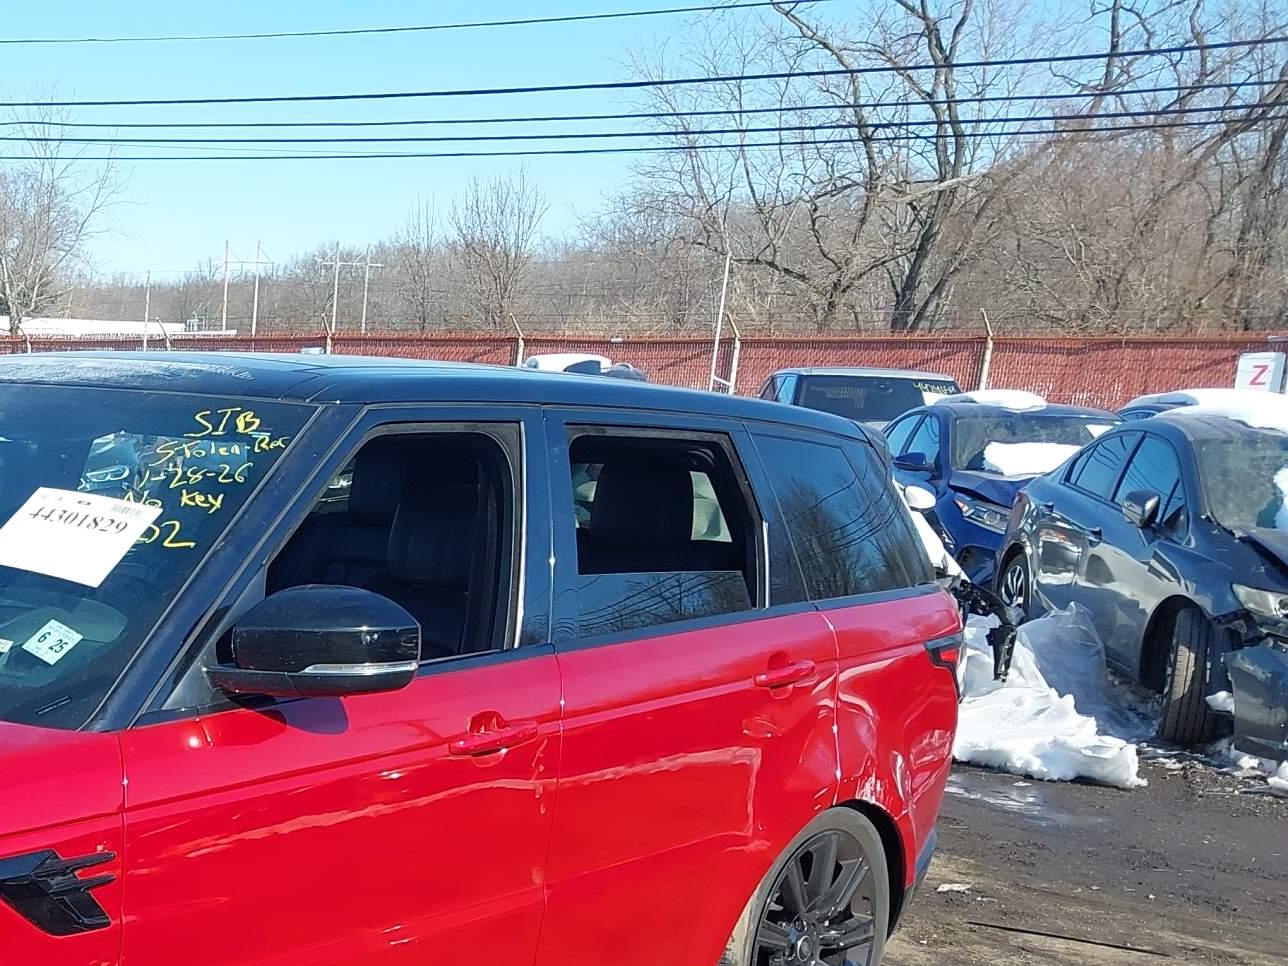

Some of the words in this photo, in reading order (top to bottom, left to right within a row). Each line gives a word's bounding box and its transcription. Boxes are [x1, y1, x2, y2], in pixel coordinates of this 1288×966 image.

[1248, 364, 1270, 386] Z
[28, 506, 128, 534] 44301829
[37, 631, 51, 643] 6
[47, 638, 68, 654] 25
